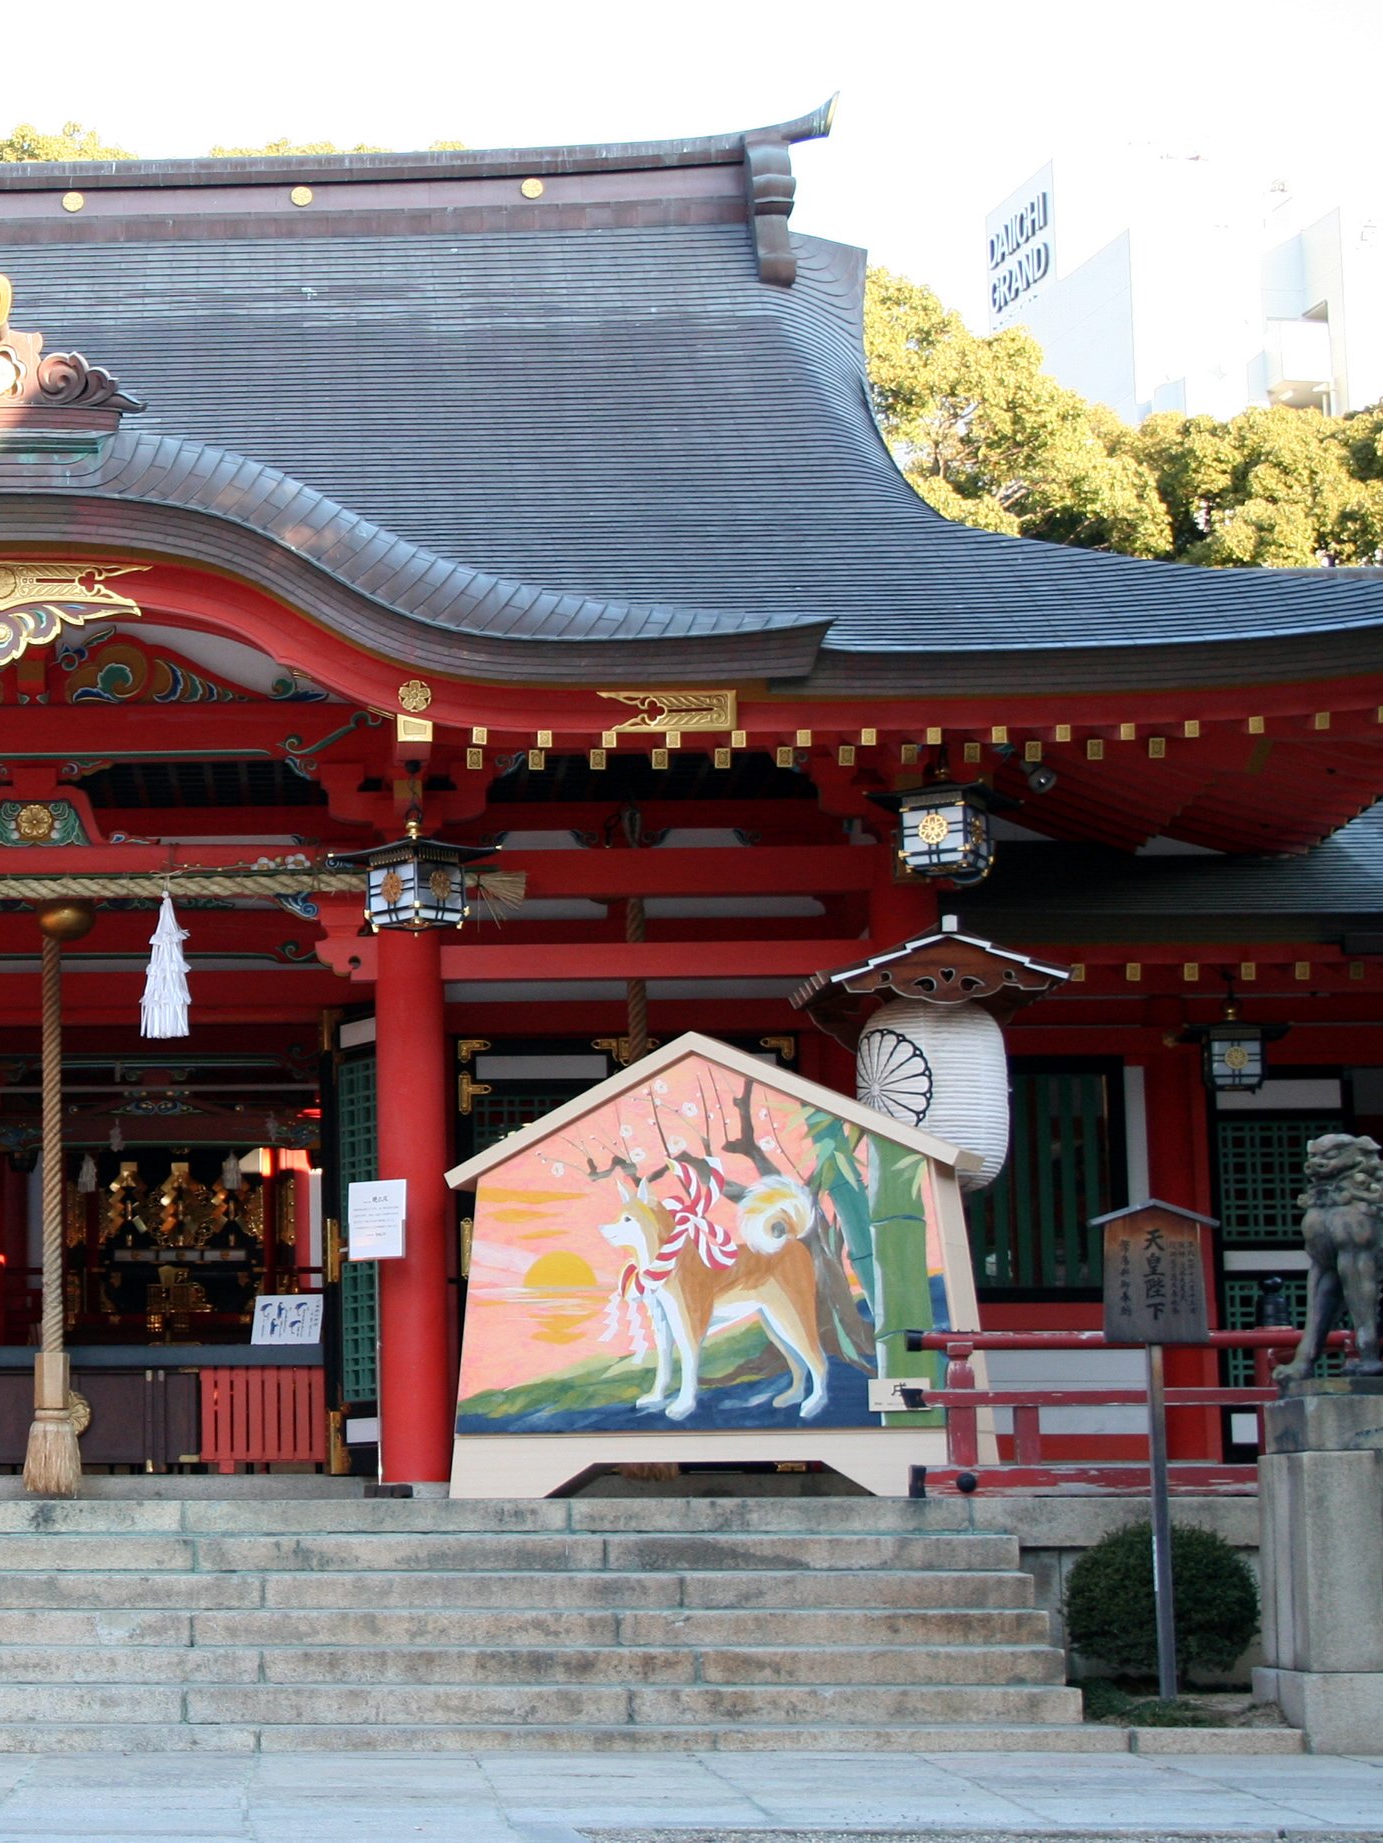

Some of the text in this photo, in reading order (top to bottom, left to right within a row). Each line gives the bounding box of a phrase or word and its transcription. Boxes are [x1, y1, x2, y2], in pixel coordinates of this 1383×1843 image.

[988, 192, 1048, 270] DAIICHI
[991, 242, 1049, 313] GRAND
[1143, 1228, 1166, 1321] 天皇陛下
